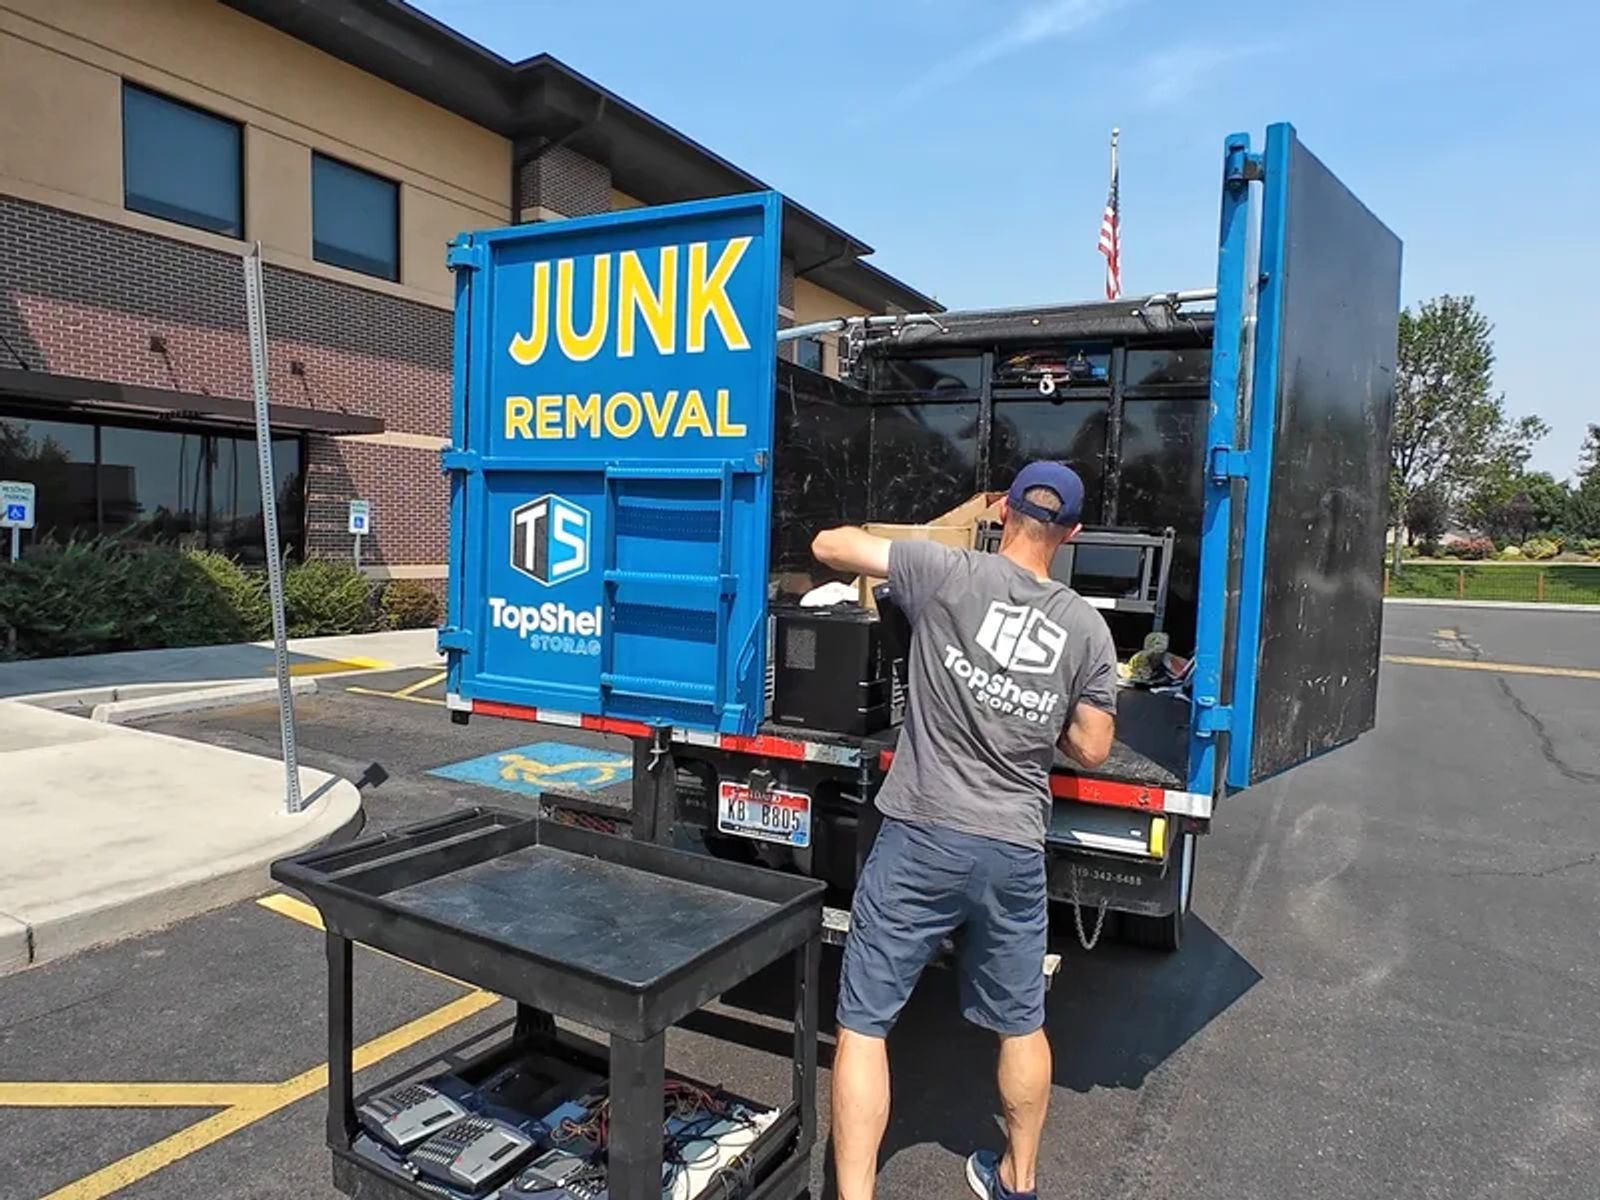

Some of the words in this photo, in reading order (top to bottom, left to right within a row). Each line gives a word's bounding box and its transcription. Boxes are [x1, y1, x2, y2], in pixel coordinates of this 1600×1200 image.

[509, 236, 753, 365] JUNK
[505, 389, 747, 440] REMOVAL
[514, 502, 586, 577] TS
[488, 598, 603, 638] TopShel
[530, 634, 602, 656] STORAG
[944, 644, 1059, 712] TopShelf
